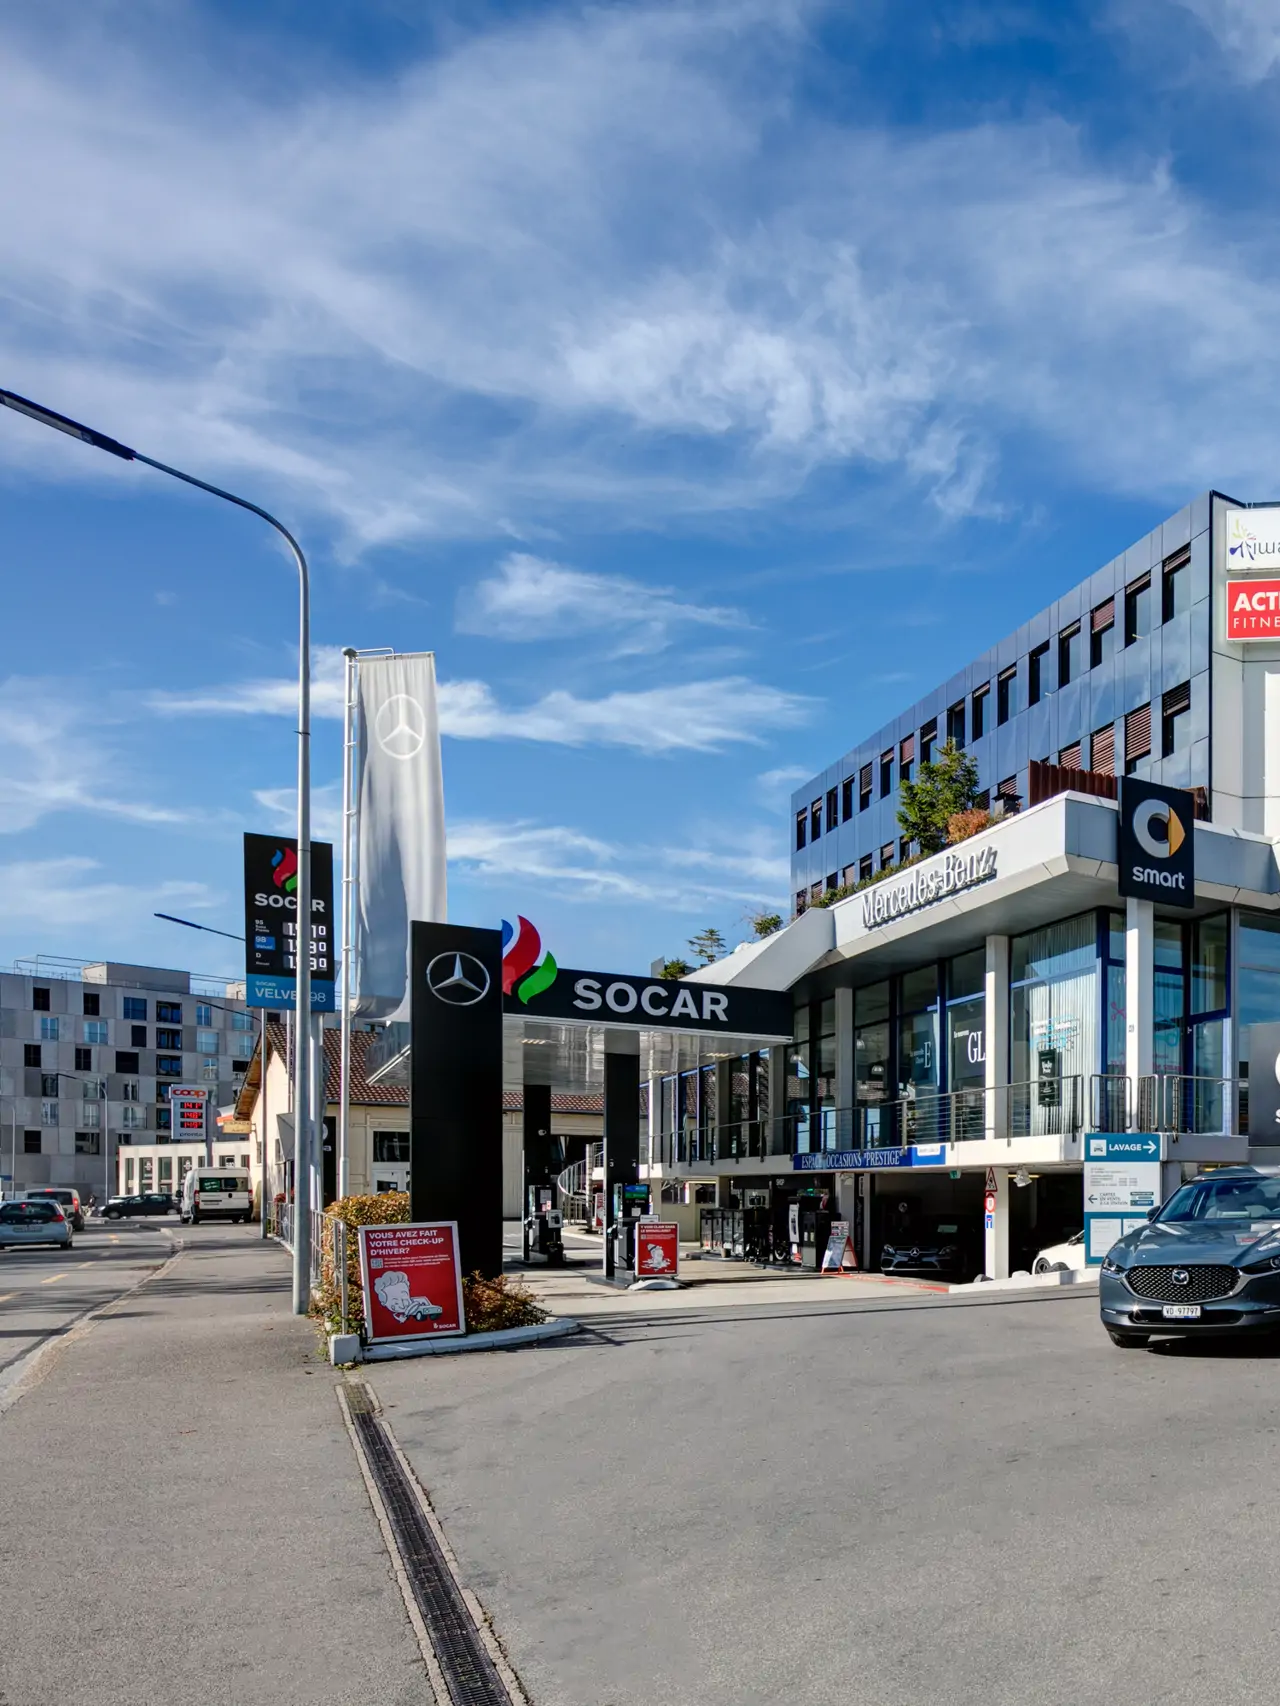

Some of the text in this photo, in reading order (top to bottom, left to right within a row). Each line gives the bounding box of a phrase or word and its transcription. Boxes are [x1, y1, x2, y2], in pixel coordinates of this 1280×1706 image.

[1132, 866, 1186, 890] smart
[861, 846, 991, 928] Mercedes-Benz
[254, 892, 325, 913] SOCR
[254, 987, 298, 1000] VELVE
[571, 978, 729, 1022] SOCAR
[967, 1030, 987, 1064] GL
[1108, 1143, 1142, 1151] LAVAGE
[826, 1151, 861, 1168] OCCASIONS
[369, 1229, 438, 1240] VOUS AVEZ FAIT
[370, 1237, 444, 1248] VOTRE CHECK-UP
[370, 1247, 410, 1256] D'HIVER?
